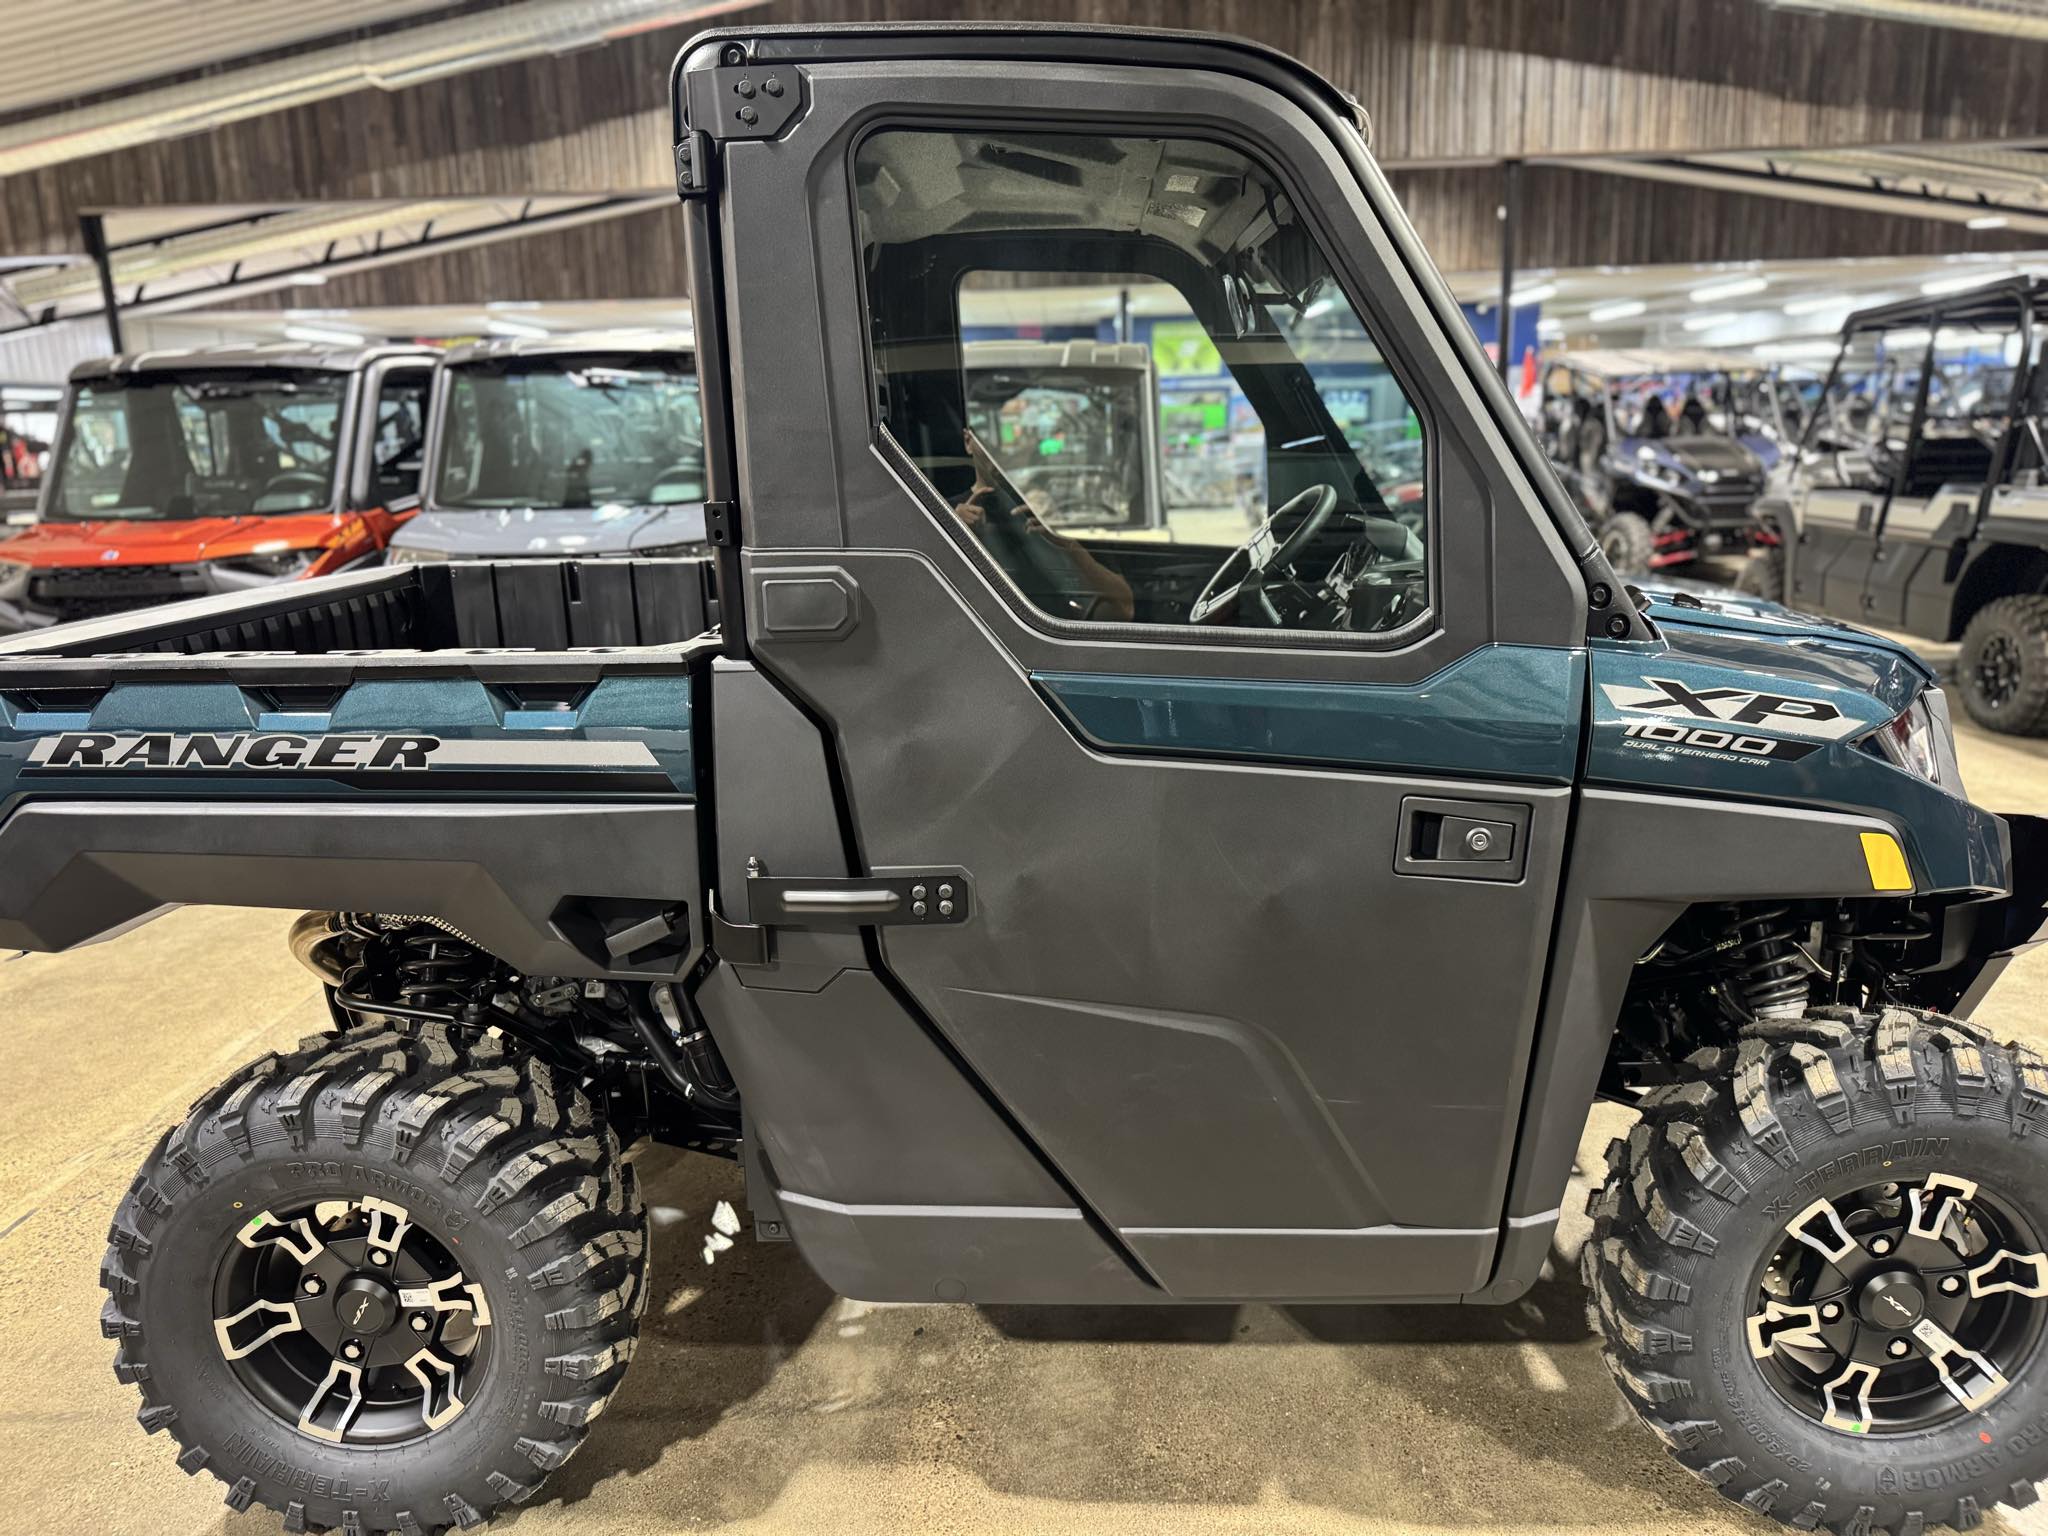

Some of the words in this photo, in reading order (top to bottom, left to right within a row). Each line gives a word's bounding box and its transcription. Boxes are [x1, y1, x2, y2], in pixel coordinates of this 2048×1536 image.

[1616, 677, 1842, 726] XP
[44, 732, 440, 770] RANGER
[1622, 724, 1778, 755] 1000
[1622, 740, 1661, 751] DUAL
[1663, 746, 1737, 761] OVERHEAD
[1738, 757, 1771, 768] CAM
[285, 1160, 344, 1178] PRO
[352, 1164, 444, 1214] ARMOR
[1762, 1137, 1951, 1222] X-TERRAIN
[352, 1296, 369, 1325] XP
[1881, 1295, 1912, 1317] XP
[222, 1431, 392, 1502] X-TERRAIN
[1903, 1449, 2001, 1492] ARMOR
